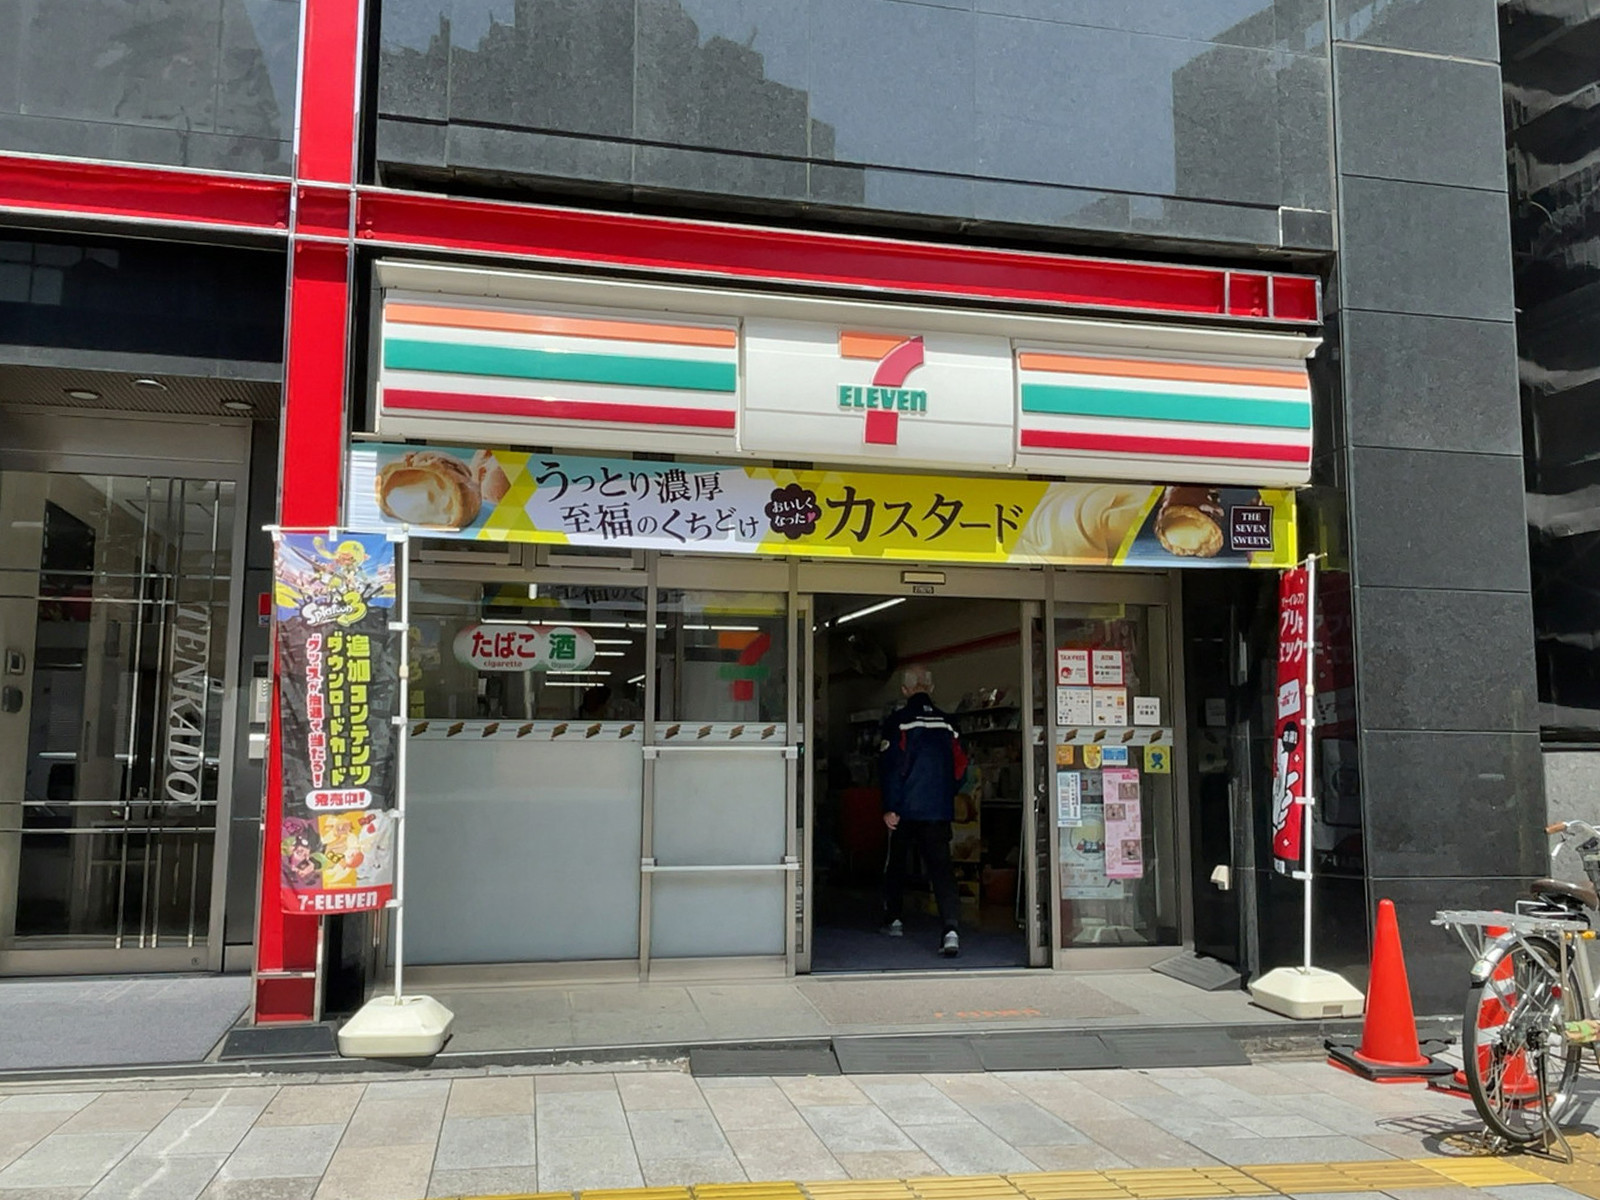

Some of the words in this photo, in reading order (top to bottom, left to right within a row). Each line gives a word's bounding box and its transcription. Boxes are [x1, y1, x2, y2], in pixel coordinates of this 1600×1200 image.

[840, 331, 924, 444] 7
[536, 461, 723, 504] うっとり濃厚
[560, 502, 759, 543] 至福のくちどけ
[772, 497, 813, 513] おいしく
[775, 512, 806, 527] なった
[825, 486, 1023, 543] カスタード
[1241, 512, 1261, 521] THE
[1233, 536, 1271, 545] SWEETS
[1235, 524, 1267, 533] SEVEN
[471, 631, 536, 659] たばこ
[549, 634, 577, 660] 酒
[166, 602, 209, 801] TENKADO
[327, 631, 347, 787] ダウンロードカード
[346, 634, 371, 785] 追加コンテンツ
